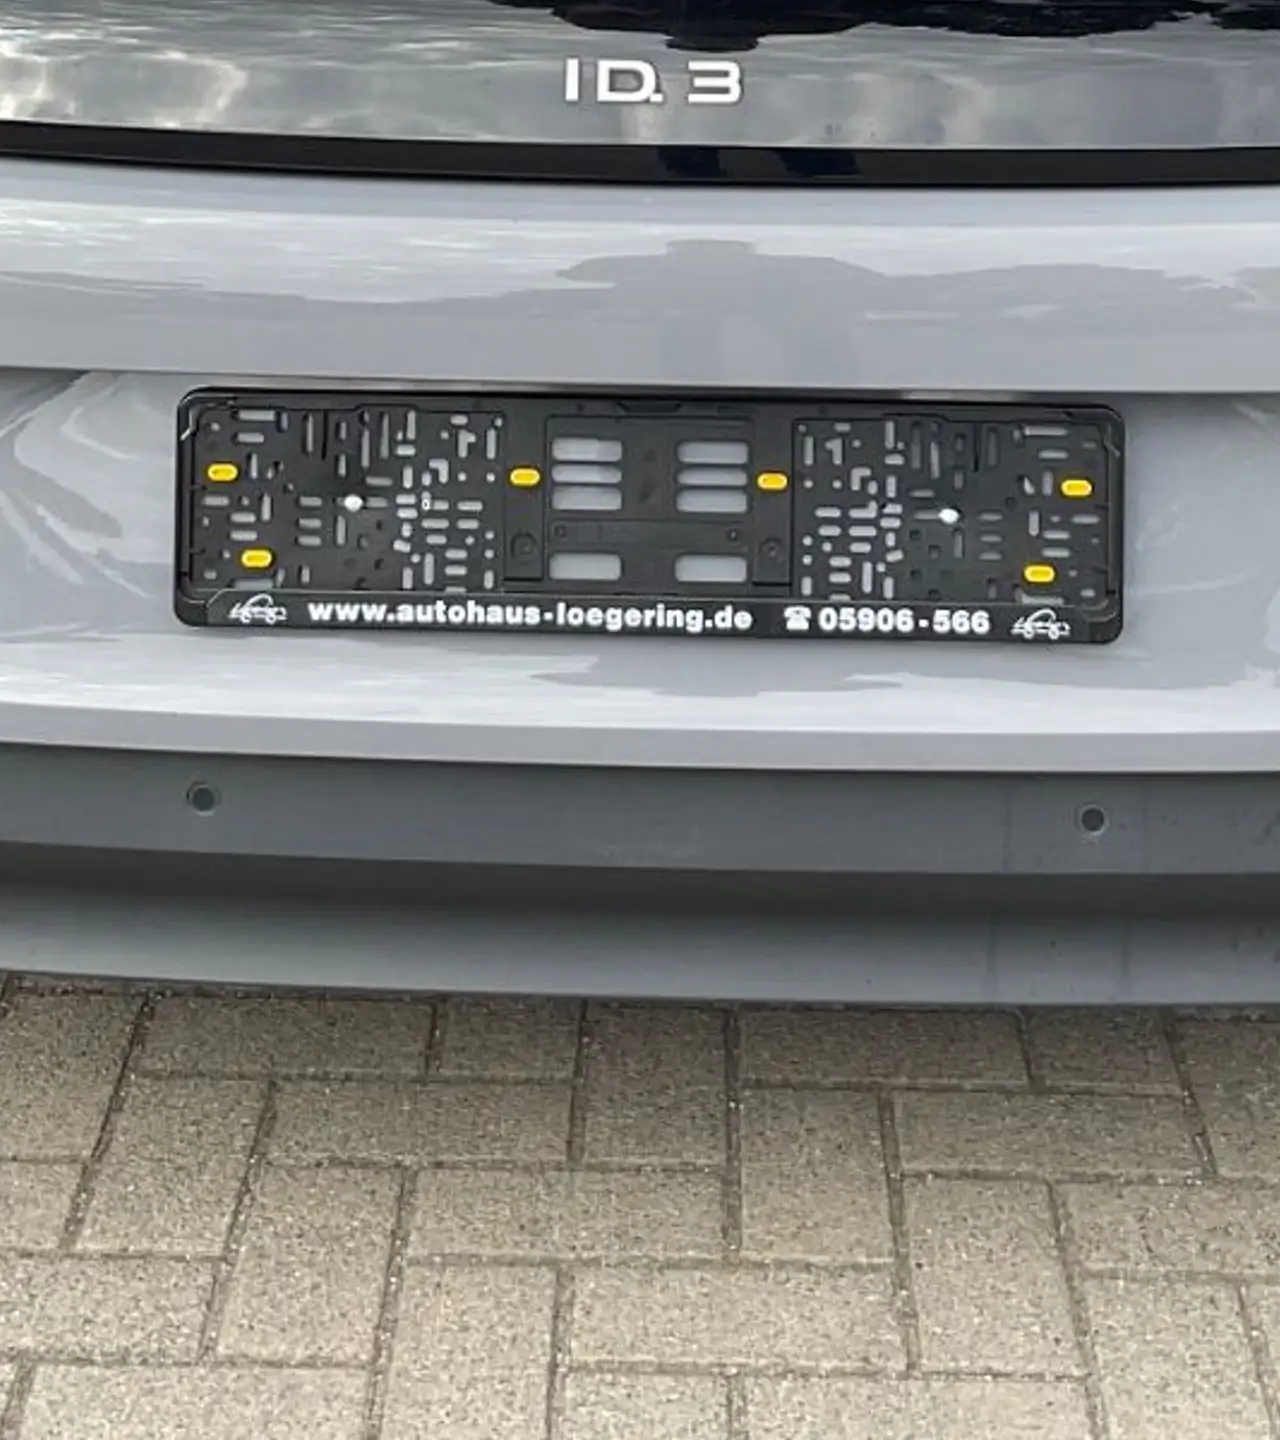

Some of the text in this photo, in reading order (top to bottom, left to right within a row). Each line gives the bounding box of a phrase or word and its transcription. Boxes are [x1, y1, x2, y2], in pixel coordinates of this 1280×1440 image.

[564, 57, 744, 104] ID.3
[307, 599, 991, 635] www.autohaus-loegering.de 05906-566
